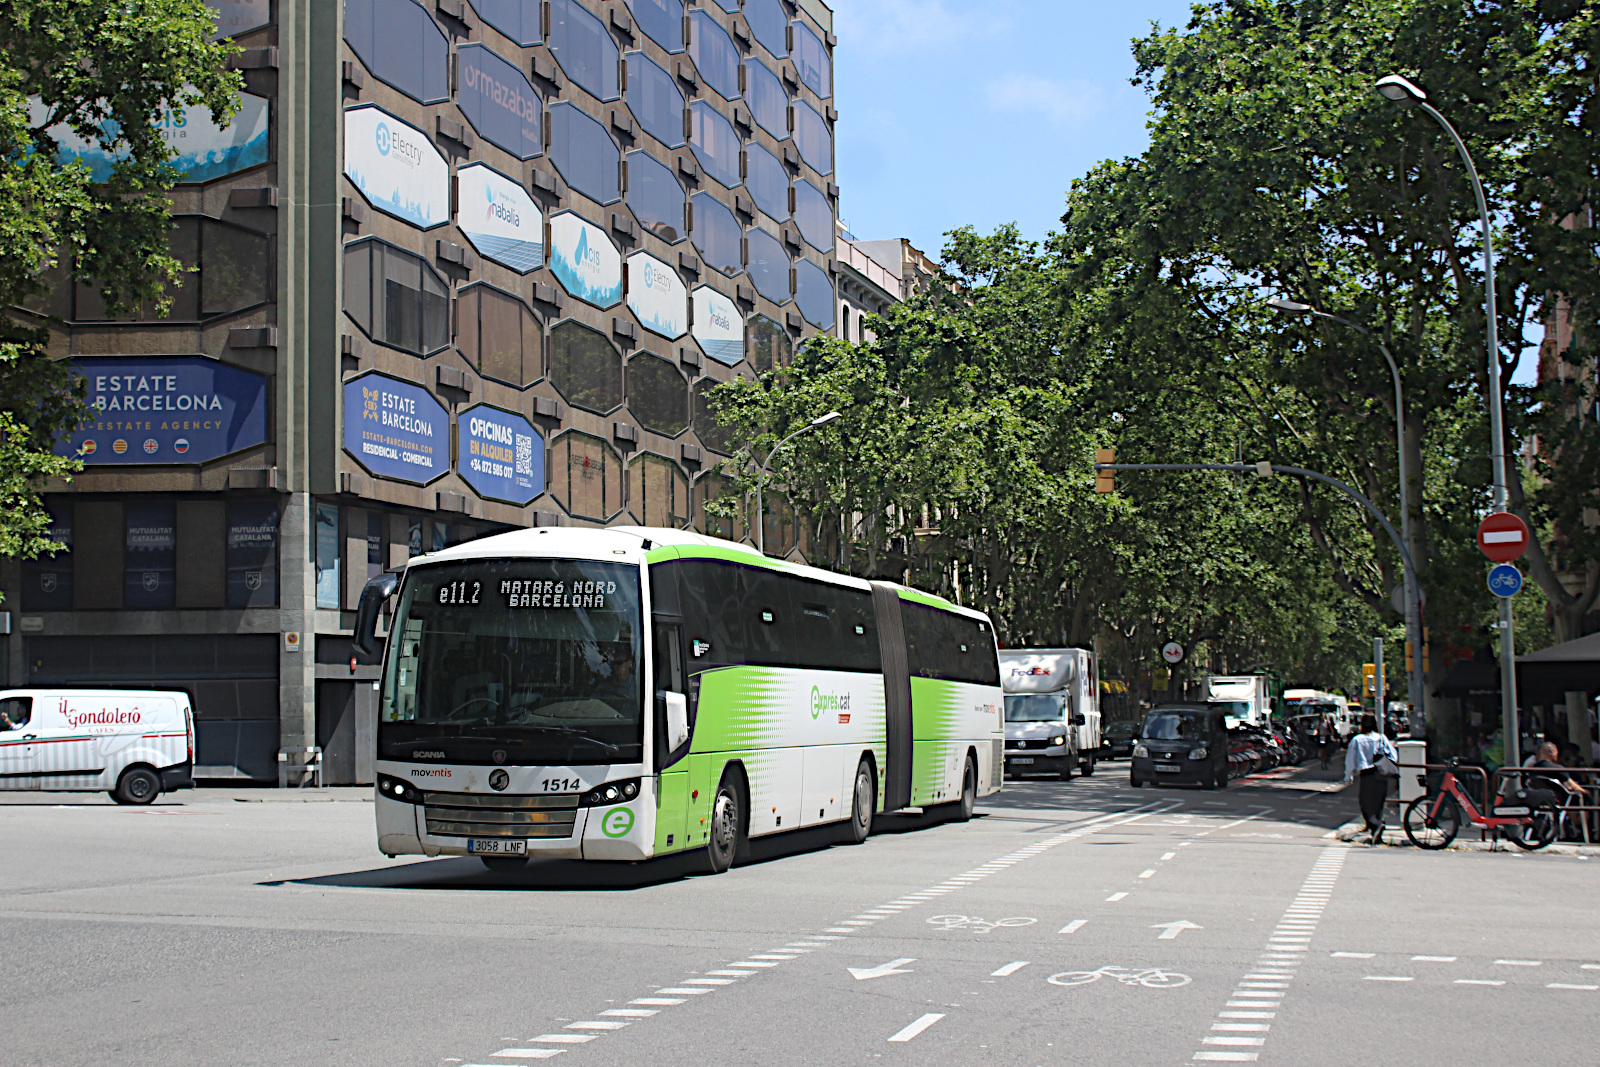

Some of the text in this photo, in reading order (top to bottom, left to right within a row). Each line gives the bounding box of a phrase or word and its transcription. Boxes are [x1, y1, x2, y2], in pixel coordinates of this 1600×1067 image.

[465, 65, 538, 126] ormazabal
[392, 132, 422, 166] Electry
[491, 203, 520, 228] nabalia
[96, 375, 177, 391] ESTATE
[96, 394, 222, 411] BARCELONA
[382, 391, 415, 415] ESTATE
[161, 420, 222, 430] AGENCY
[382, 410, 433, 437] BARCELONA
[470, 417, 513, 446] OFICINAS
[362, 430, 433, 455] ESTATE-BARCELONA.COM
[470, 439, 514, 464] EN ALQUILER
[362, 442, 433, 468] RESIDENCIAL COMERCIAL
[470, 458, 514, 479] +34 872 585 017
[129, 527, 173, 535] MUTUALITAT
[439, 581, 481, 604] e11.2
[573, 581, 617, 595] NORD
[509, 594, 605, 608] BARCELONA
[1011, 667, 1051, 677] FedEx
[412, 751, 446, 759] SCANIA
[411, 768, 452, 778] moventis
[541, 778, 581, 792] 1514
[475, 840, 523, 853] 3058 LNF
